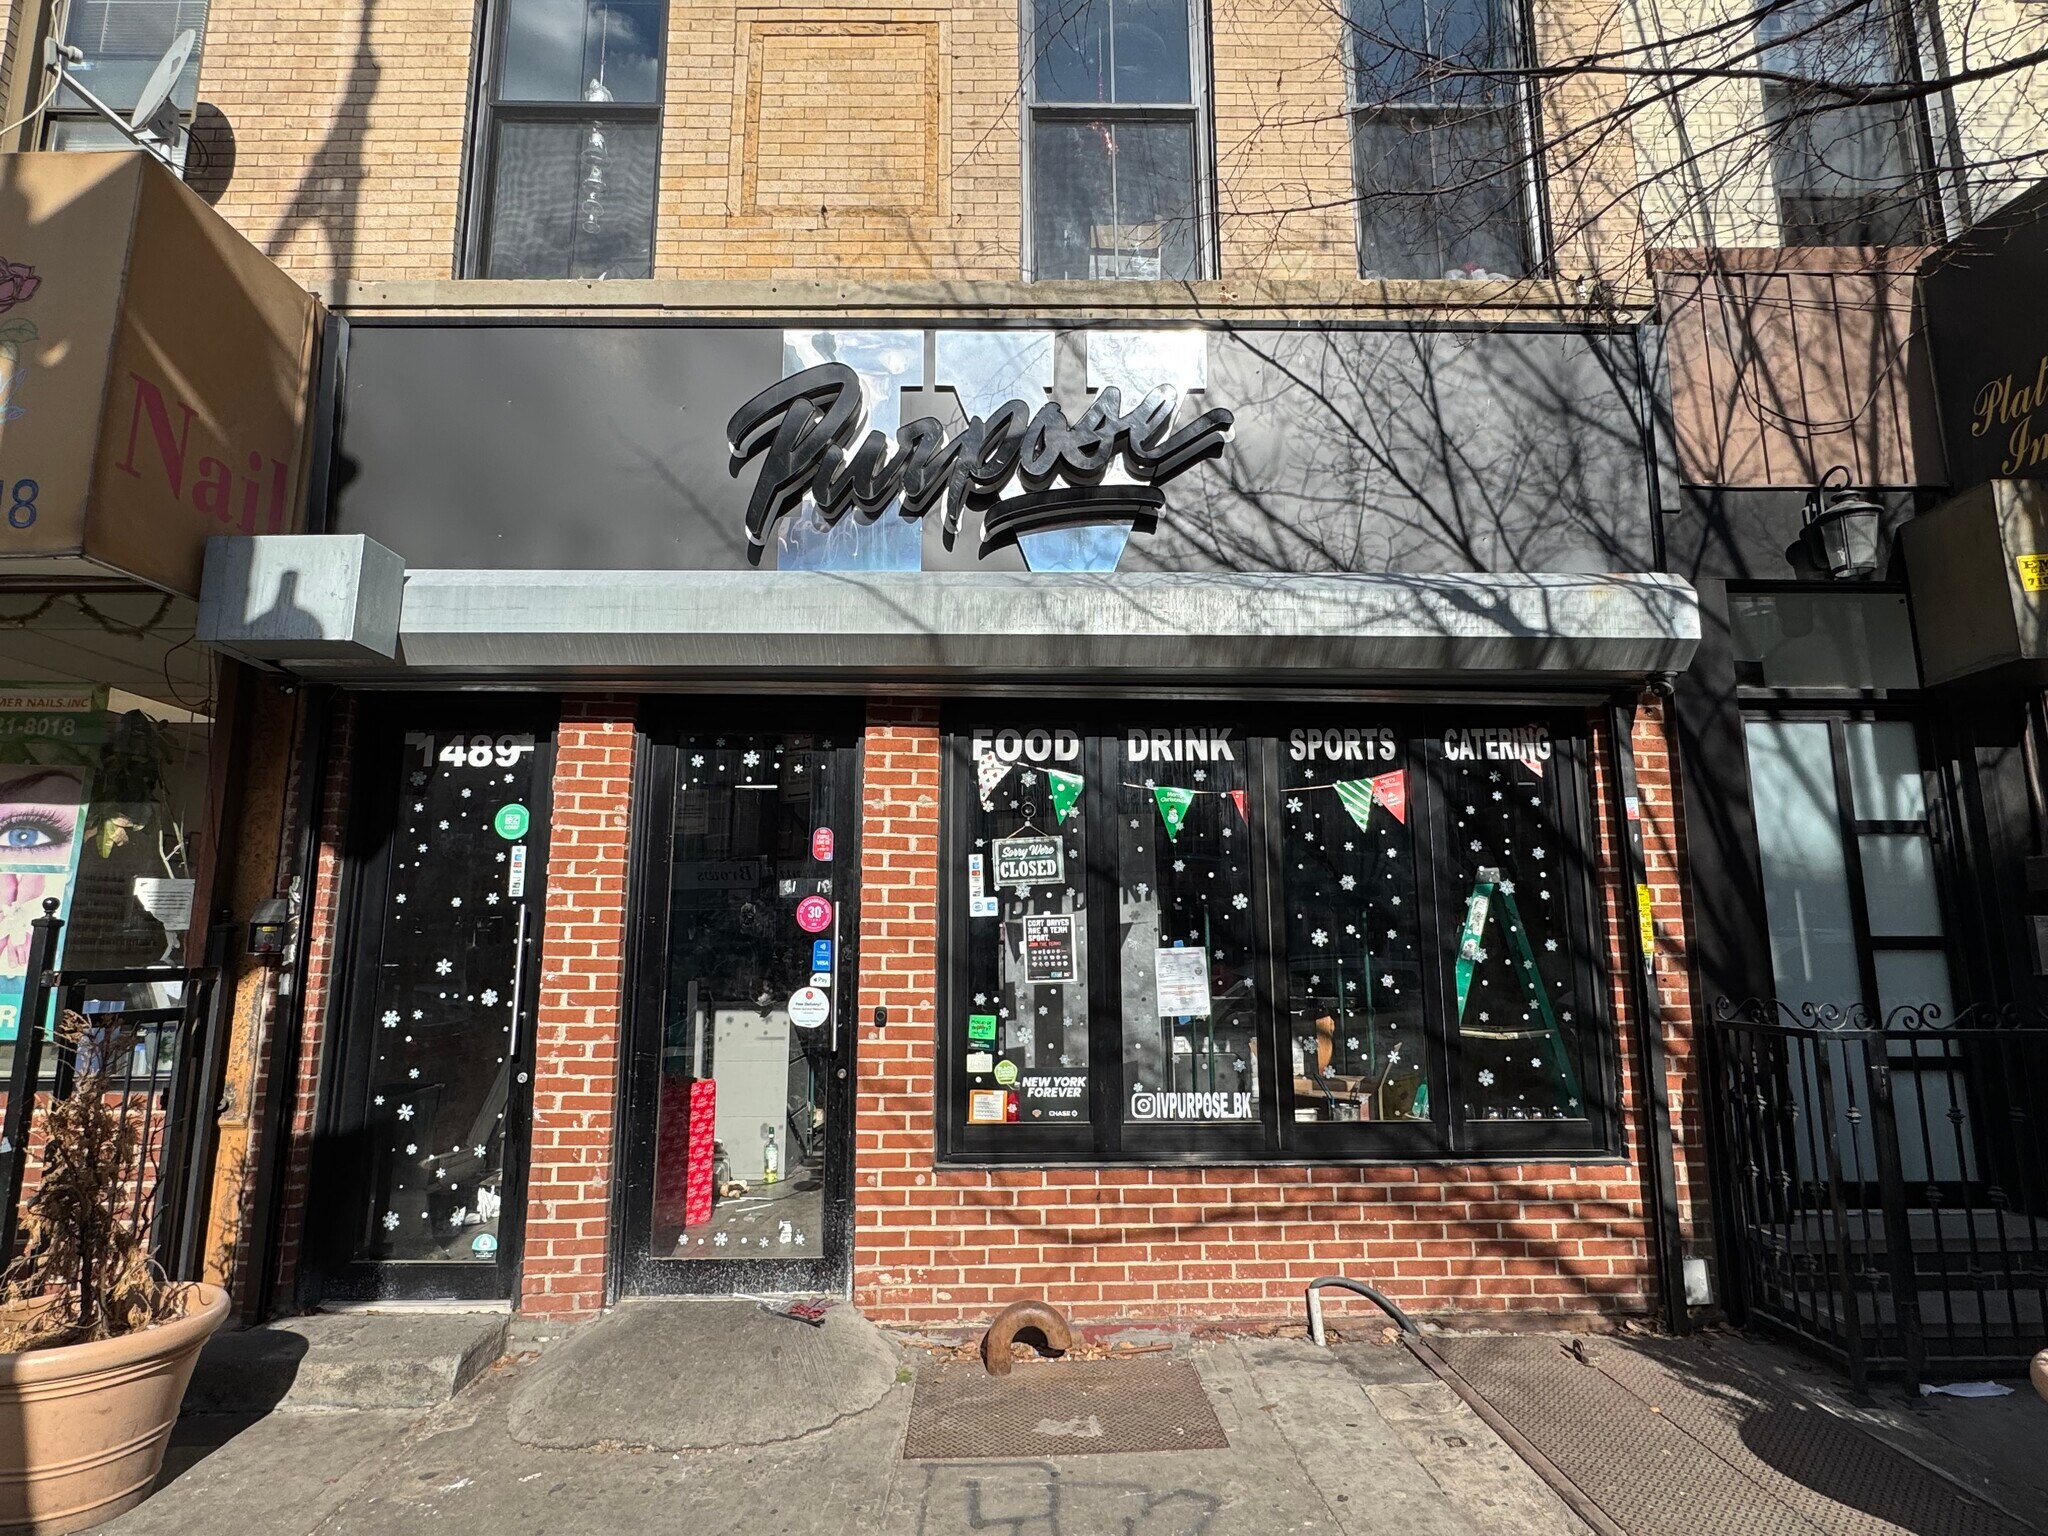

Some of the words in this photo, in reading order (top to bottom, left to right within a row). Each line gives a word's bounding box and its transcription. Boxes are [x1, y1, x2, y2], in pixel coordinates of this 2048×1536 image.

[115, 371, 288, 535] Nail
[727, 361, 1235, 552] Purpose
[0, 479, 39, 529] 8
[405, 732, 535, 767] 1489
[972, 728, 1080, 762] FOOD
[1127, 728, 1235, 762] DRINK
[1289, 728, 1396, 761] SPORTS
[1444, 728, 1551, 761] CATERING
[1000, 859, 1057, 878] CLOSED
[1001, 846, 1028, 860] Sorry
[1027, 919, 1045, 927] COAT
[1046, 918, 1070, 926] DRIVES
[1027, 927, 1042, 935] ARE
[1043, 926, 1049, 934] A
[1050, 926, 1068, 934] TEAM
[1022, 1076, 1051, 1088] NEW
[1053, 1076, 1087, 1088] YORK
[1027, 1087, 1082, 1098] FOREVER
